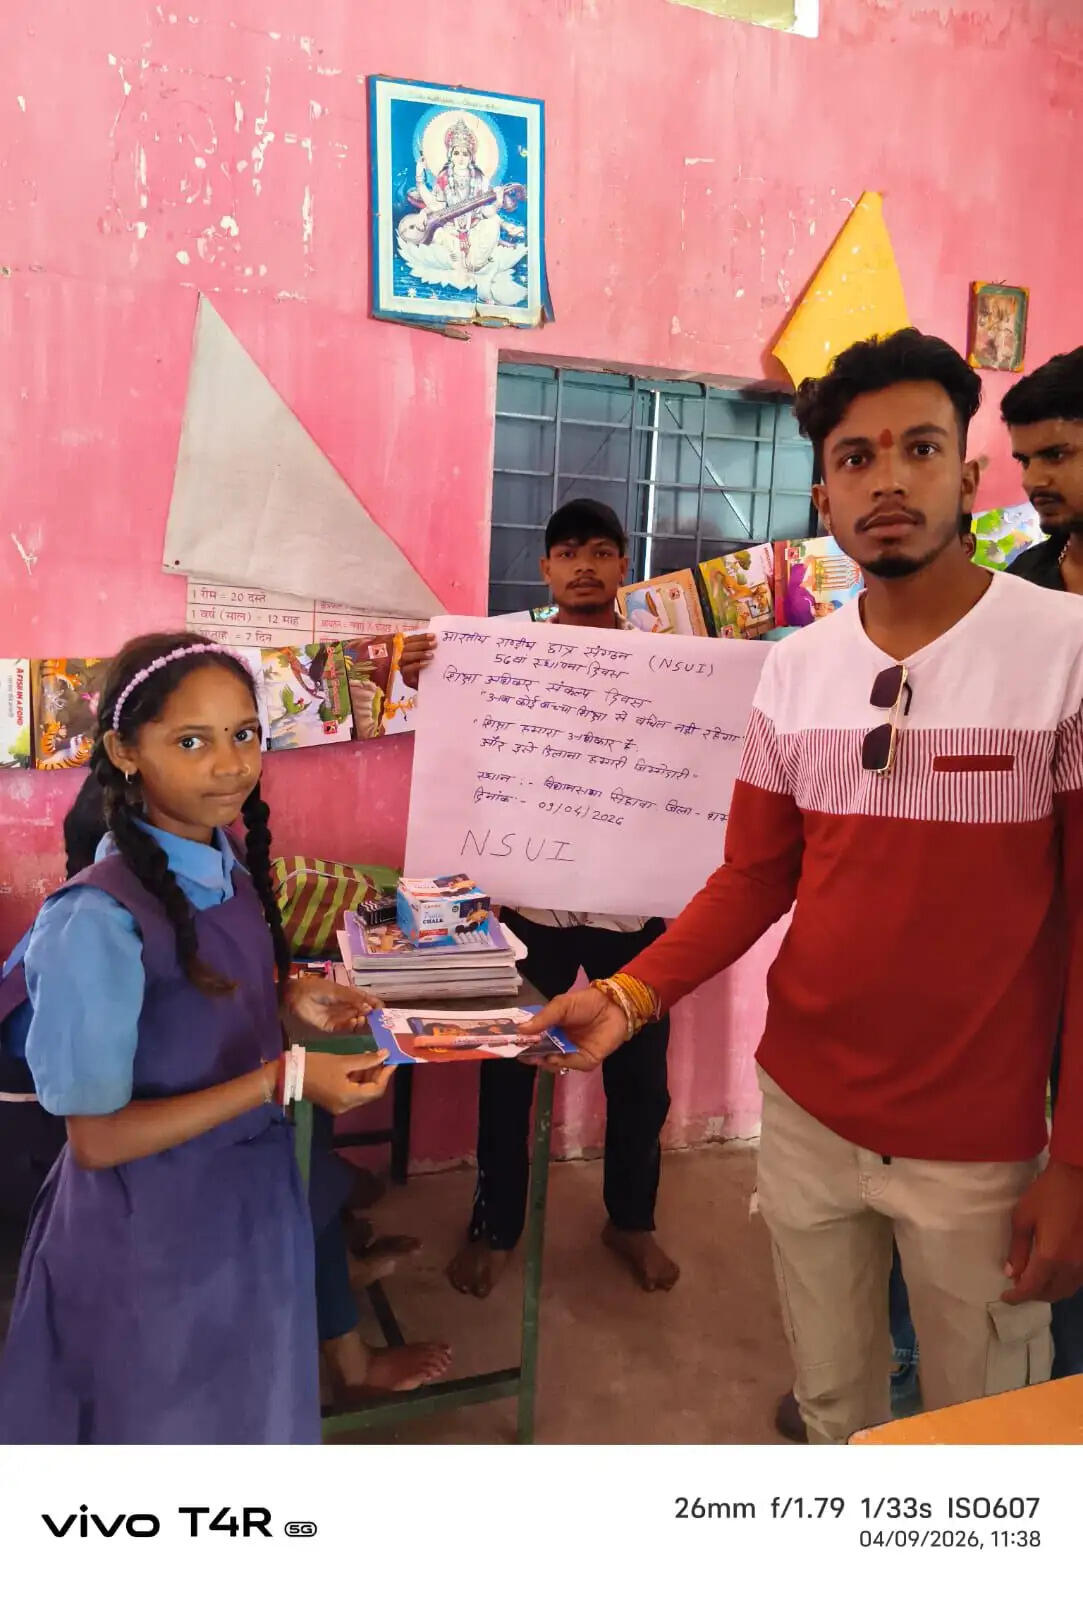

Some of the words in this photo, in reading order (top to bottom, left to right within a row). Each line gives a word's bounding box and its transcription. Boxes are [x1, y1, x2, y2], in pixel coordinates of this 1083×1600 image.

[231, 591, 245, 602] 20
[200, 607, 216, 619] वर्ष
[267, 615, 279, 624] 12
[281, 615, 301, 625] माह
[255, 630, 273, 642] दिन
[441, 630, 491, 645] भारतीय
[547, 642, 579, 657] छात्र
[584, 645, 633, 661] संगठन
[648, 655, 715, 678] (NSUI)
[586, 660, 630, 679] दिवस
[16, 674, 24, 691] FISH
[442, 664, 483, 686] शिक्षा
[545, 680, 596, 700] संकल्प
[604, 687, 652, 709] दिवस
[16, 691, 24, 700] IN
[16, 706, 24, 727] POND
[515, 694, 541, 710] कोई
[576, 705, 608, 723] शिक्षा
[615, 710, 628, 723] से
[480, 735, 508, 752] और
[512, 741, 539, 755] उसे
[586, 754, 628, 770] हमारी
[664, 798, 693, 816] जिला
[460, 829, 575, 862] NSUI
